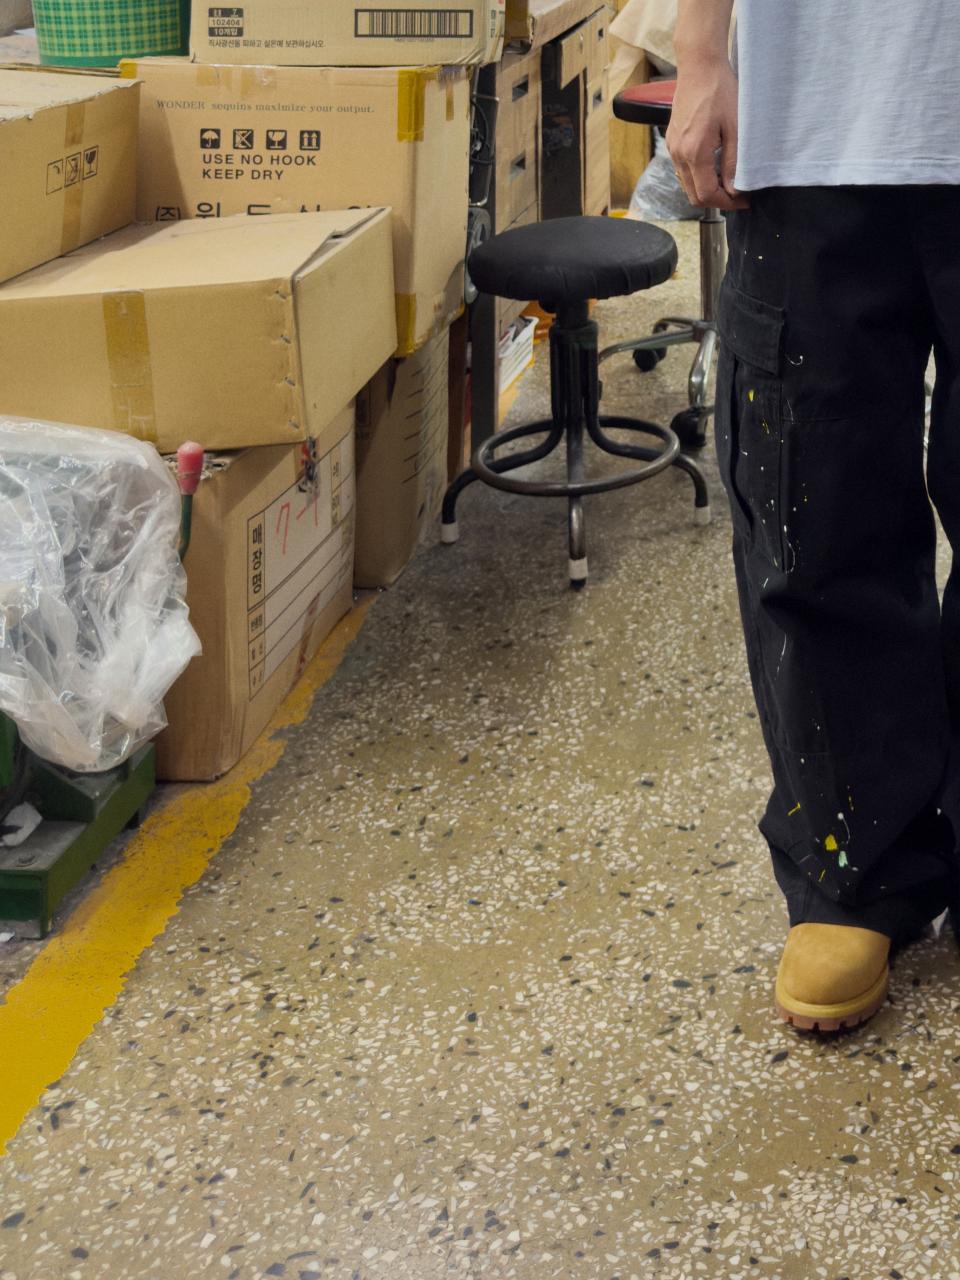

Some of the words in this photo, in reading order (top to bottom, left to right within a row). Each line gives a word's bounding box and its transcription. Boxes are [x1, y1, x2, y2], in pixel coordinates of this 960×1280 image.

[156, 99, 206, 110] WONDER
[212, 102, 252, 112] sequins
[255, 103, 306, 112] maximize
[309, 104, 333, 113] your
[337, 105, 375, 114] output.
[202, 154, 234, 165] USE
[241, 154, 264, 165] NO
[270, 155, 317, 166] HOOK
[202, 169, 245, 180] KEEP
[251, 169, 284, 180] DRY
